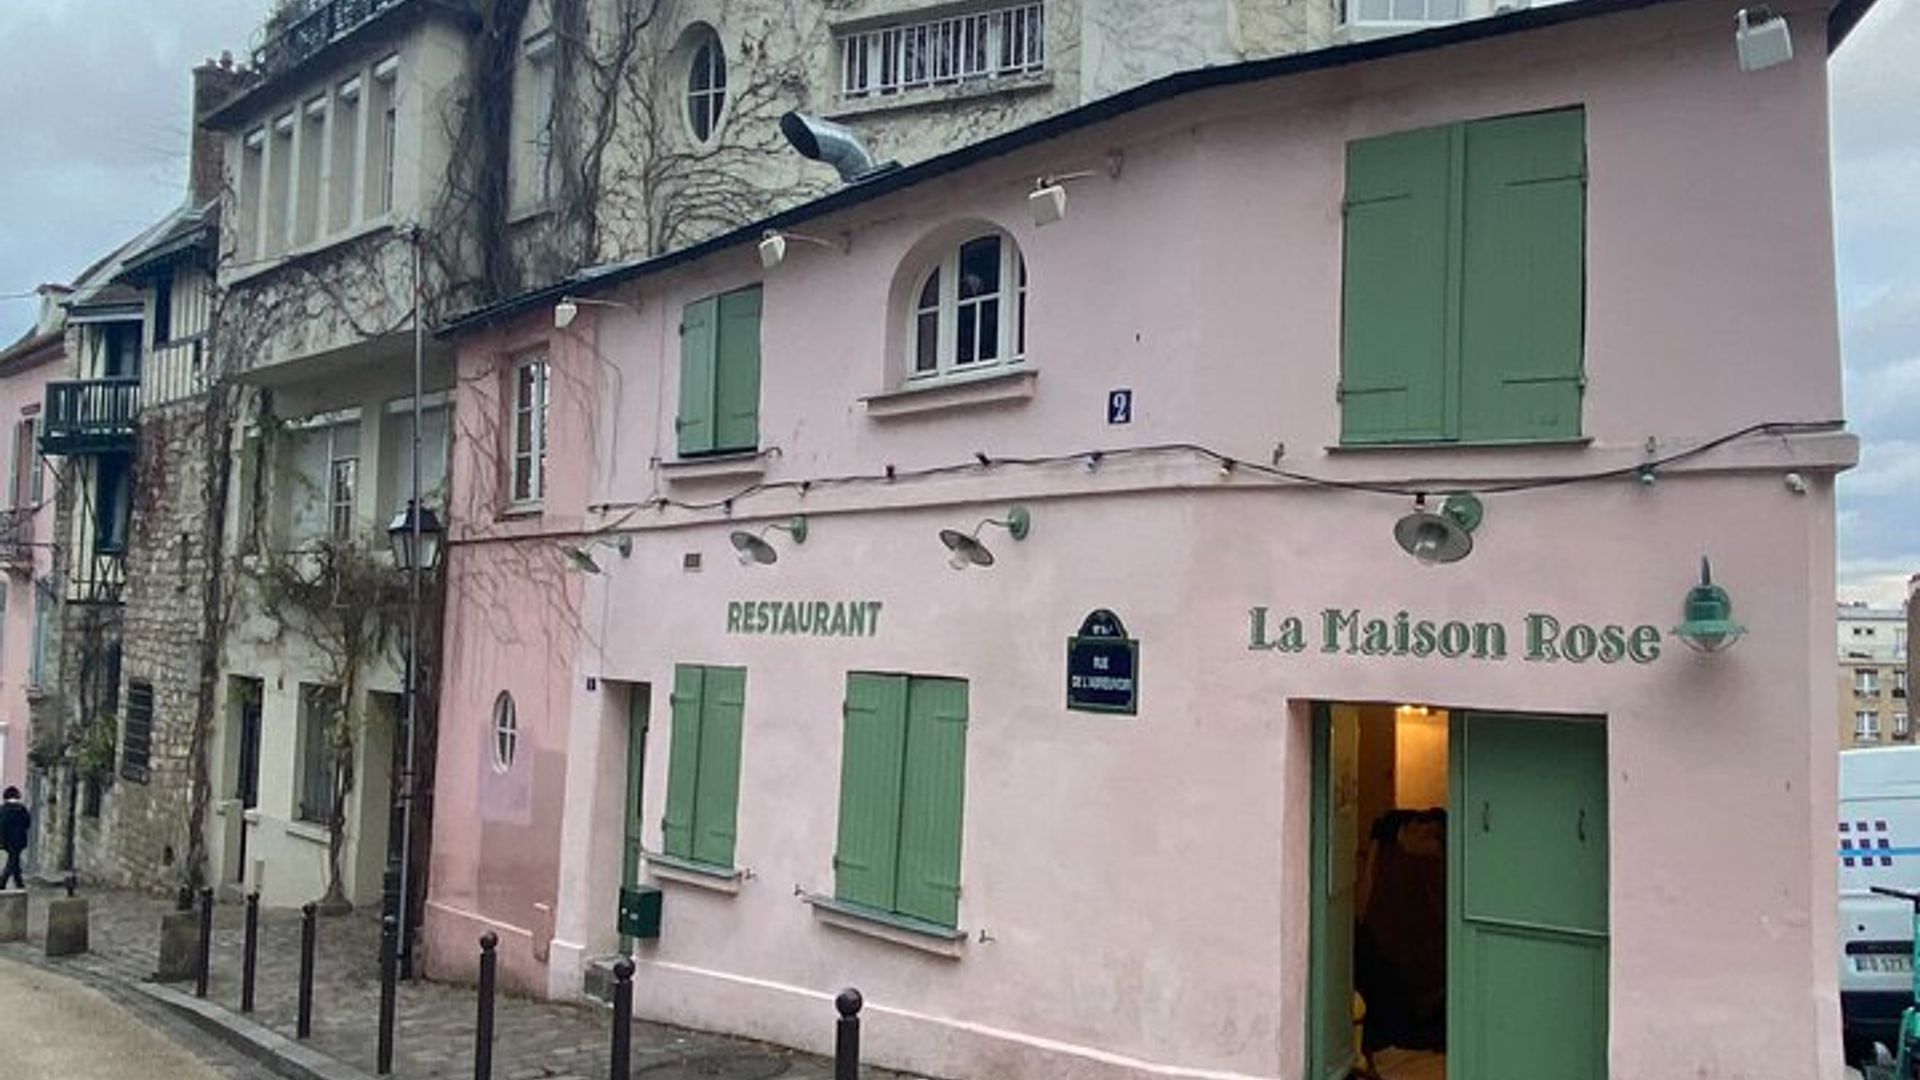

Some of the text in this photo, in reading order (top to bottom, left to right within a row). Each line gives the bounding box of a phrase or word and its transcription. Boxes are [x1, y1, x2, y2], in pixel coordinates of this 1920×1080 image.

[1112, 393, 1127, 421] 2
[727, 601, 882, 636] RESTAURANT
[1248, 606, 1661, 664] La Maison Rose
